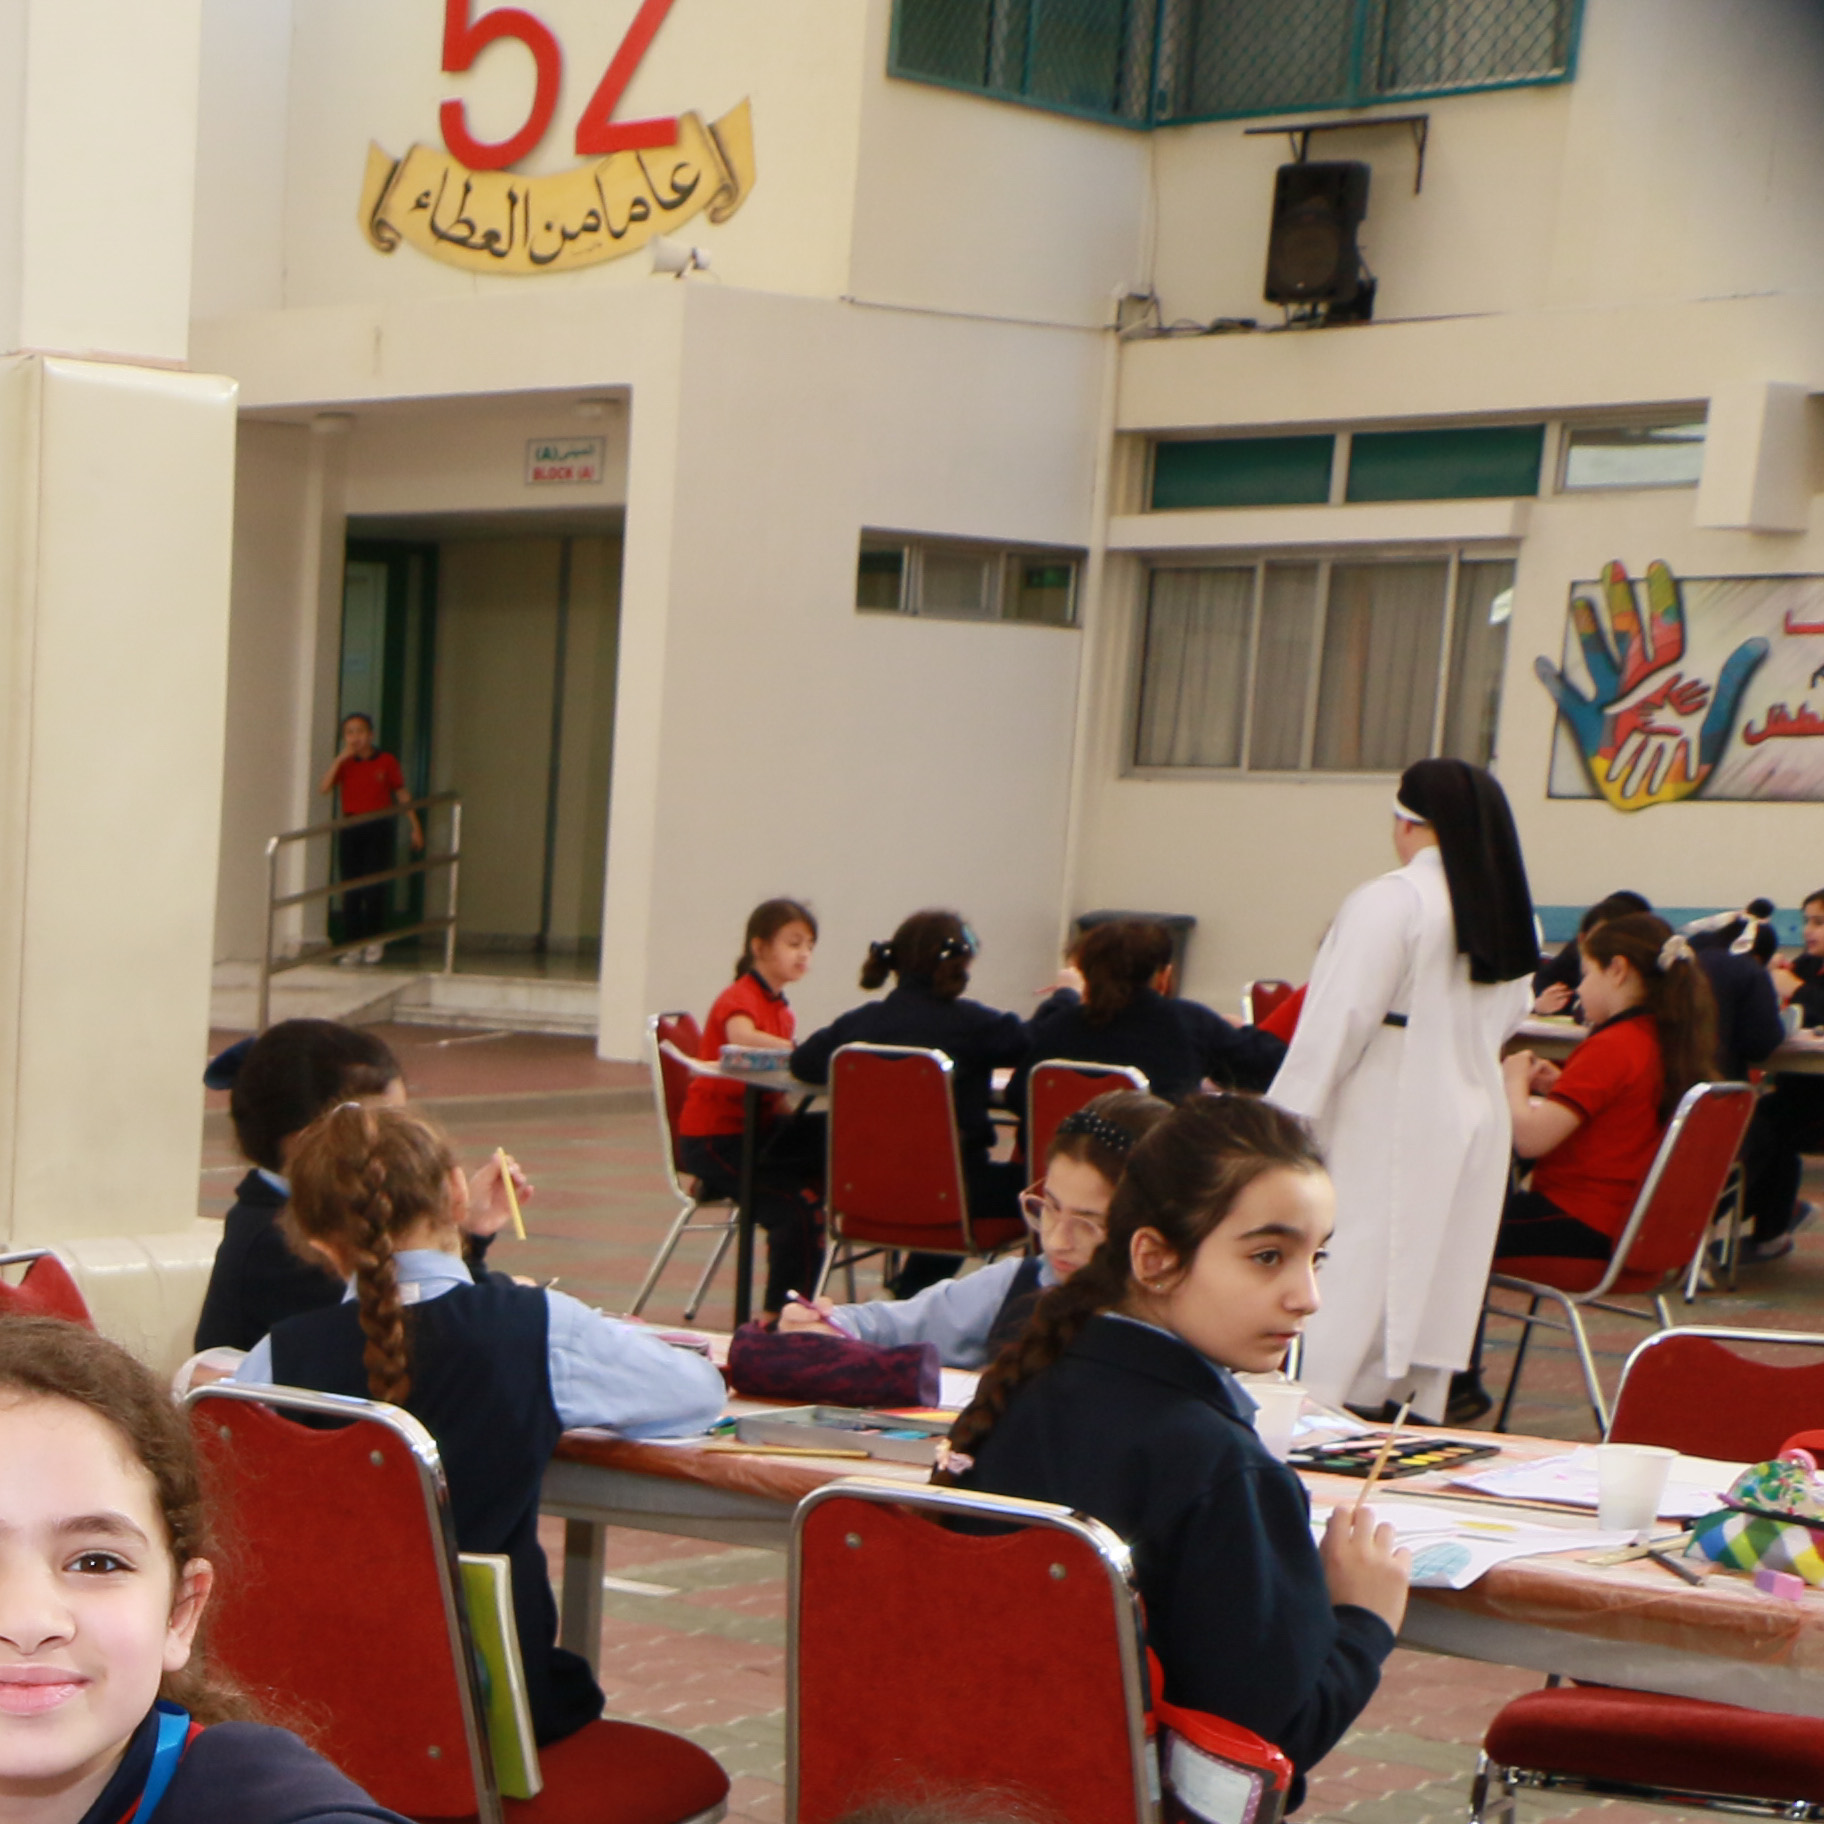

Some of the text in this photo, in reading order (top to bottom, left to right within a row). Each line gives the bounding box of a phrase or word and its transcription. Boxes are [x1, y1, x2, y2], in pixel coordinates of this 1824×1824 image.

[409, 167, 530, 258] العطاء
[529, 208, 602, 265] من
[532, 467, 574, 482] BLOCK
